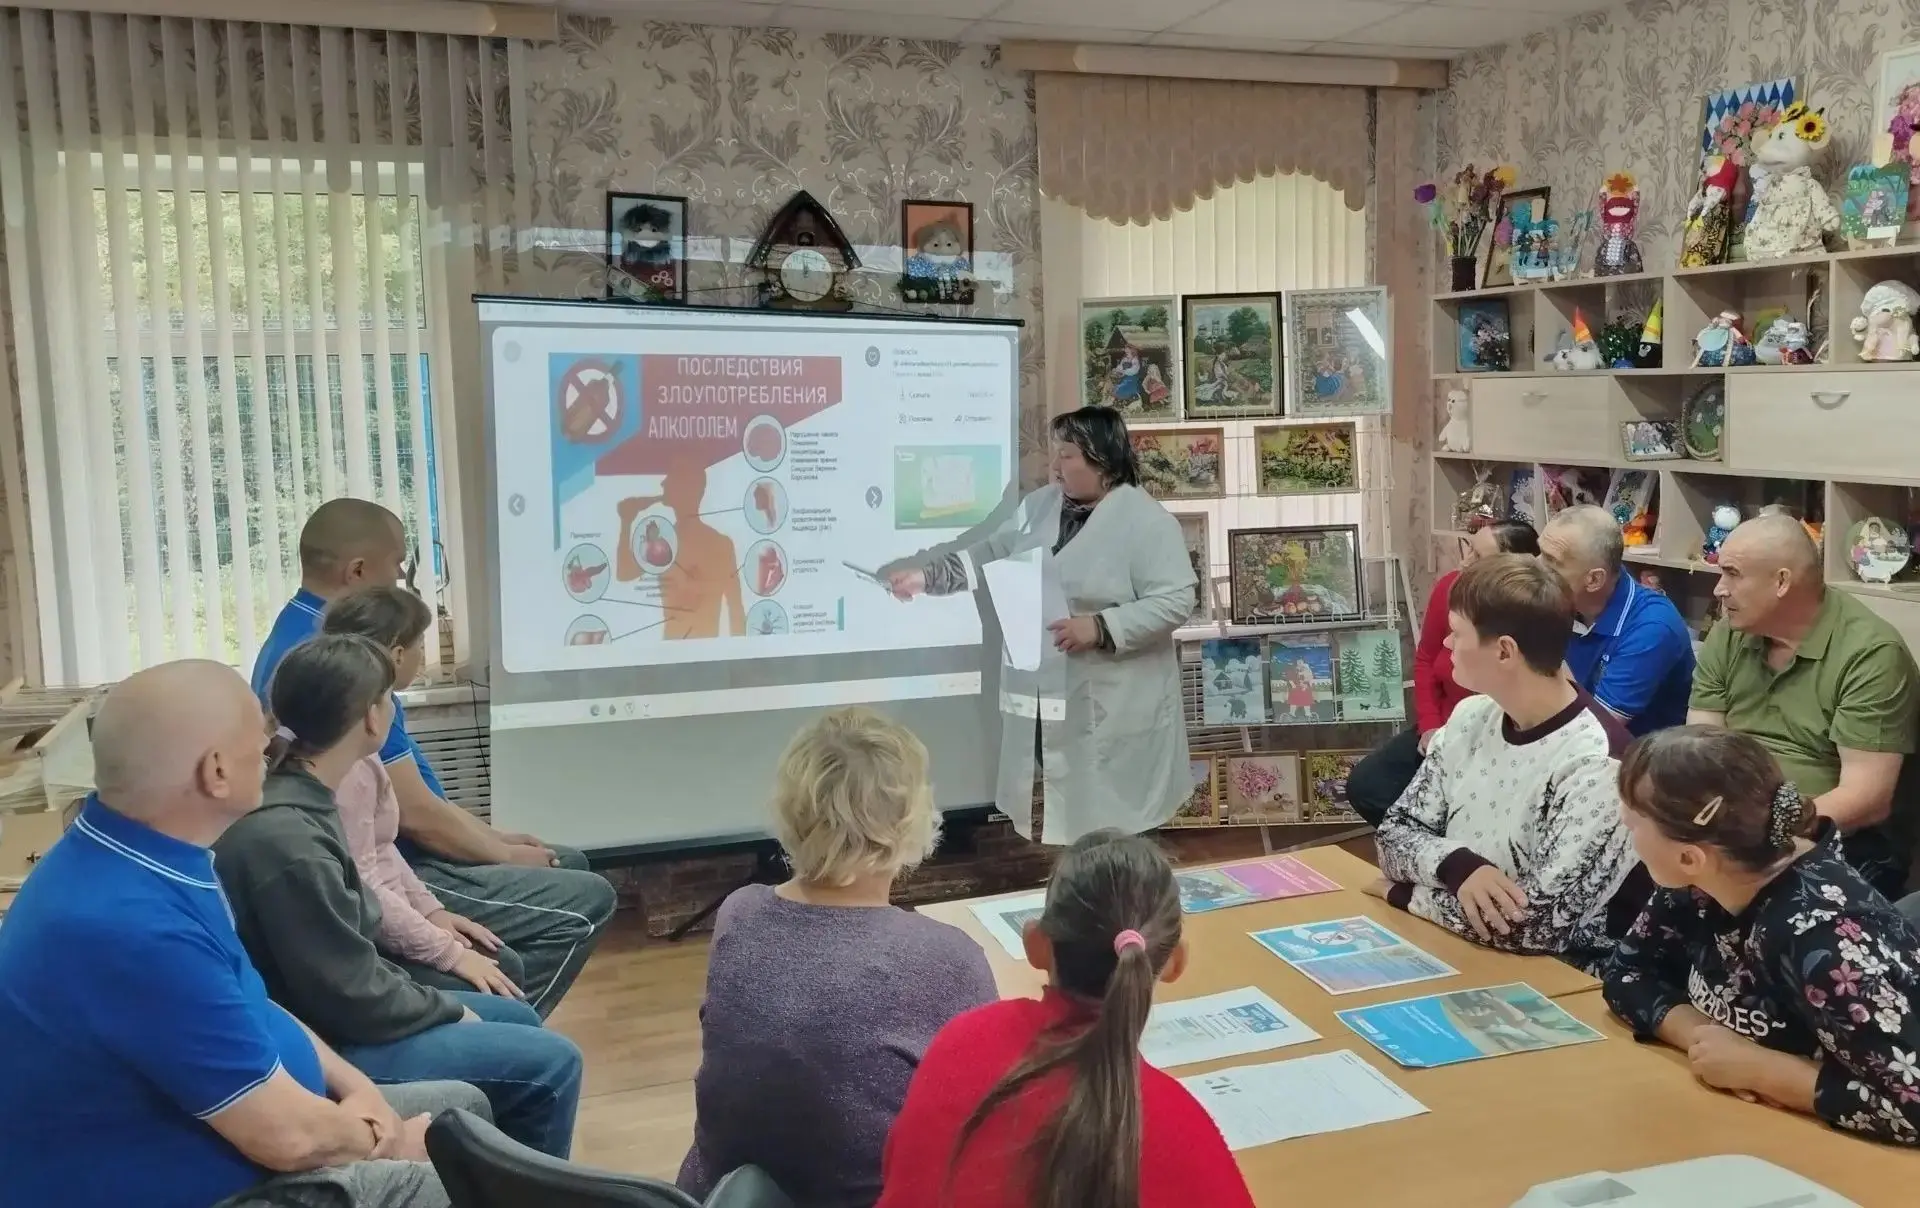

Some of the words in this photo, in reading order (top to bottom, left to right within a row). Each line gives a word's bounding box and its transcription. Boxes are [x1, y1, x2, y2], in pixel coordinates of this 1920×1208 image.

[677, 357, 804, 379] ПОСЛЕДСТВИЯ
[657, 385, 828, 405] ЗЛОУПОТРЕБЛЕНИЯ
[648, 414, 740, 439] АЛКОГОЛЕМ
